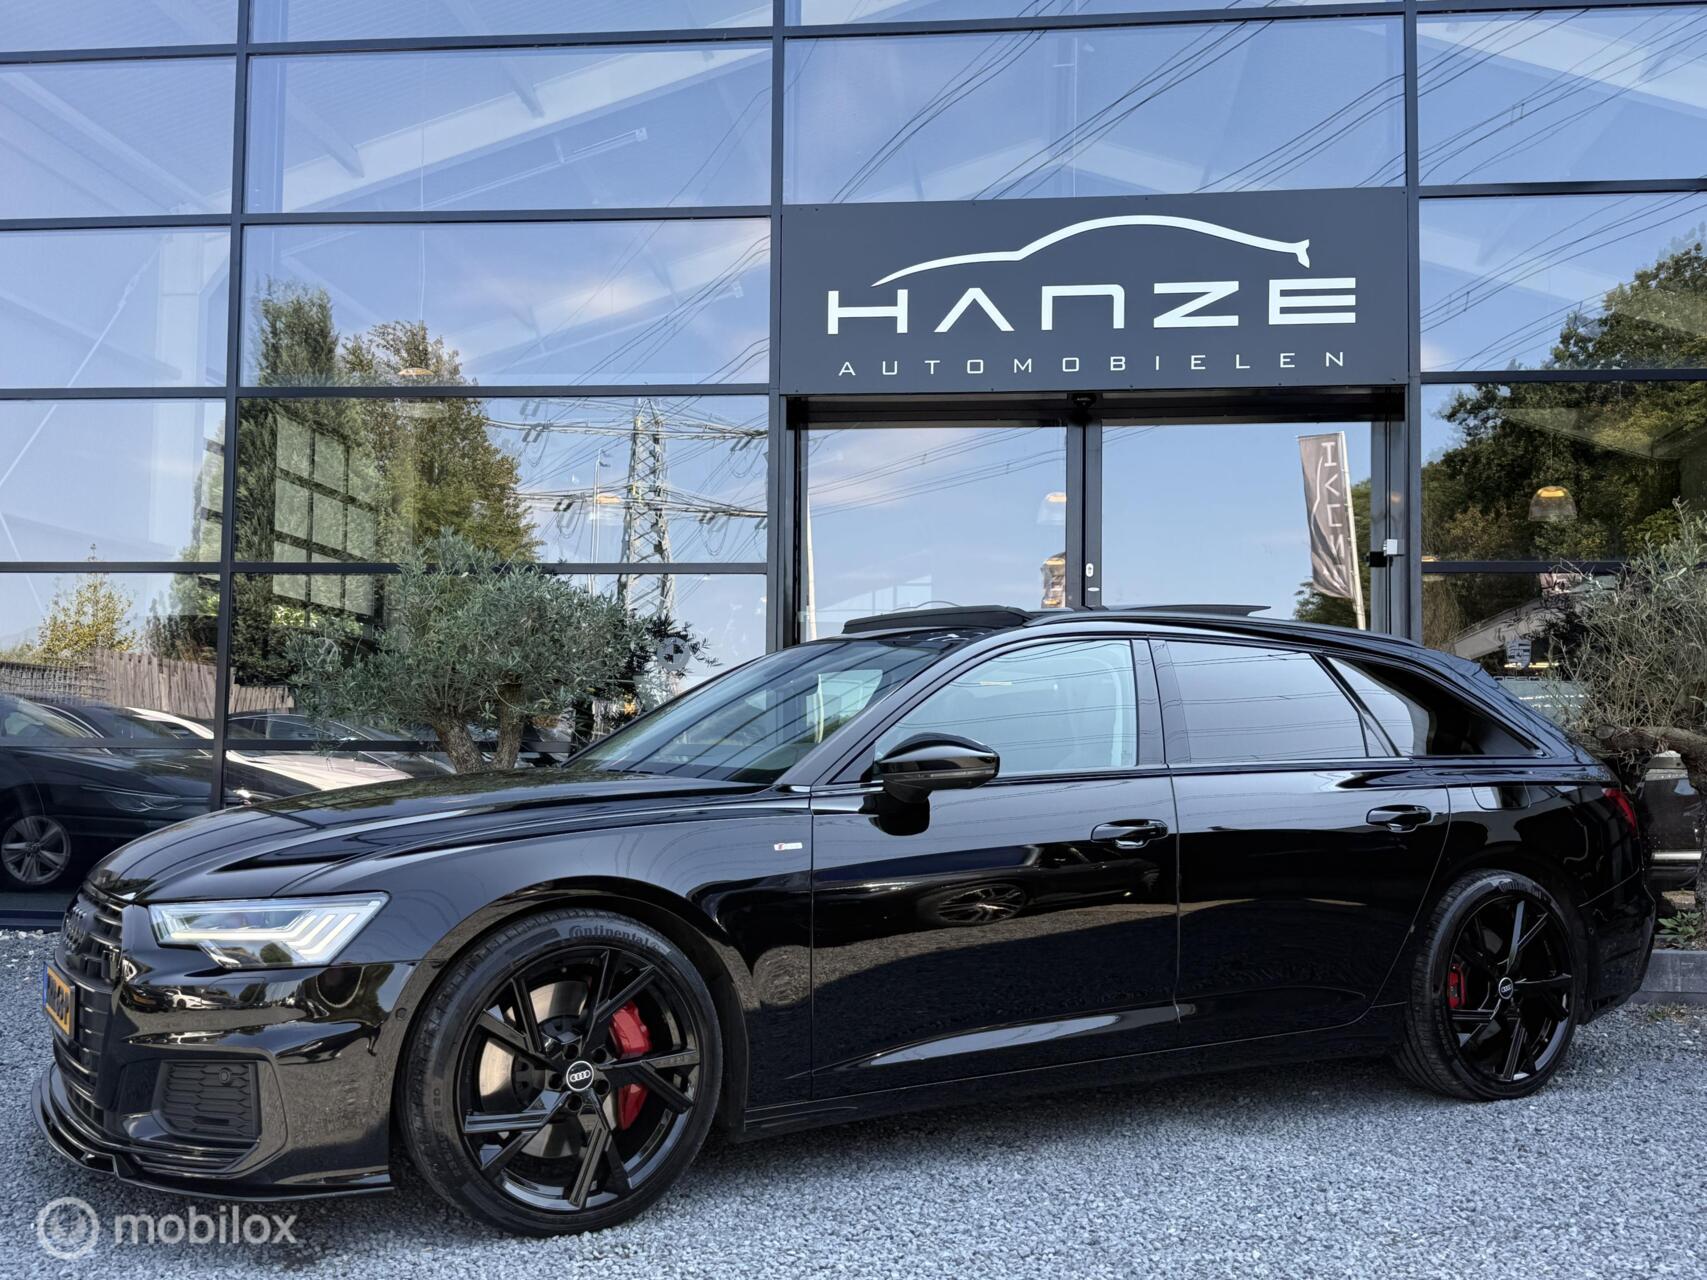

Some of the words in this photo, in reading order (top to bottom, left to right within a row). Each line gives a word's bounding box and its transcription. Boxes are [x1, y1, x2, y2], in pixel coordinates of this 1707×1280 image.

[827, 277, 1356, 335] HANZE
[838, 351, 1344, 376] AUTOMOBIELEN
[569, 925, 648, 949] Continental
